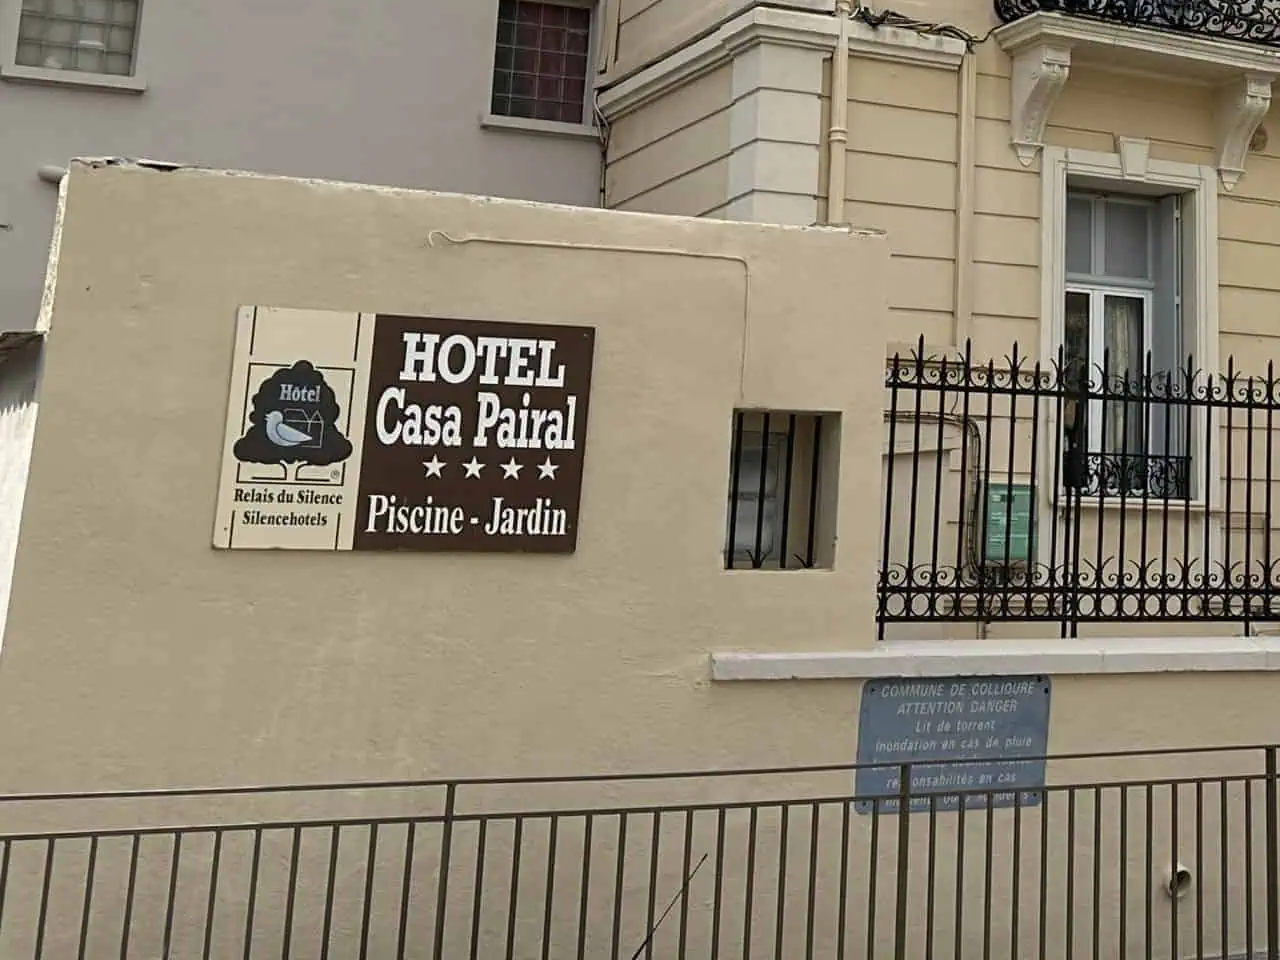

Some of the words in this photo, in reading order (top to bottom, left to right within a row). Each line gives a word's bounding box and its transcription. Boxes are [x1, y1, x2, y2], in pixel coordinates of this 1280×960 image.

[400, 332, 565, 388] HOTEL
[375, 387, 462, 447] Casa
[473, 391, 577, 451] Pairal
[234, 488, 274, 504] Relais
[277, 489, 294, 504] du
[296, 489, 343, 505] Silence
[242, 510, 328, 527] Silencehotels
[364, 494, 464, 535] Piscine
[485, 496, 567, 536] Jardin
[881, 683, 945, 698] COMMUNE
[950, 683, 968, 696] DE
[971, 681, 1035, 696] COLLIOURE
[897, 701, 964, 716] ATTENTION
[970, 699, 1018, 713] DANGER
[915, 720, 931, 733] Lit
[937, 720, 951, 732] de
[957, 719, 996, 731] torrent
[942, 740, 956, 751] en
[960, 737, 979, 750] cas
[985, 736, 999, 748] de
[1005, 735, 1033, 751] pluie
[979, 774, 993, 785] en
[997, 770, 1017, 783] cas
